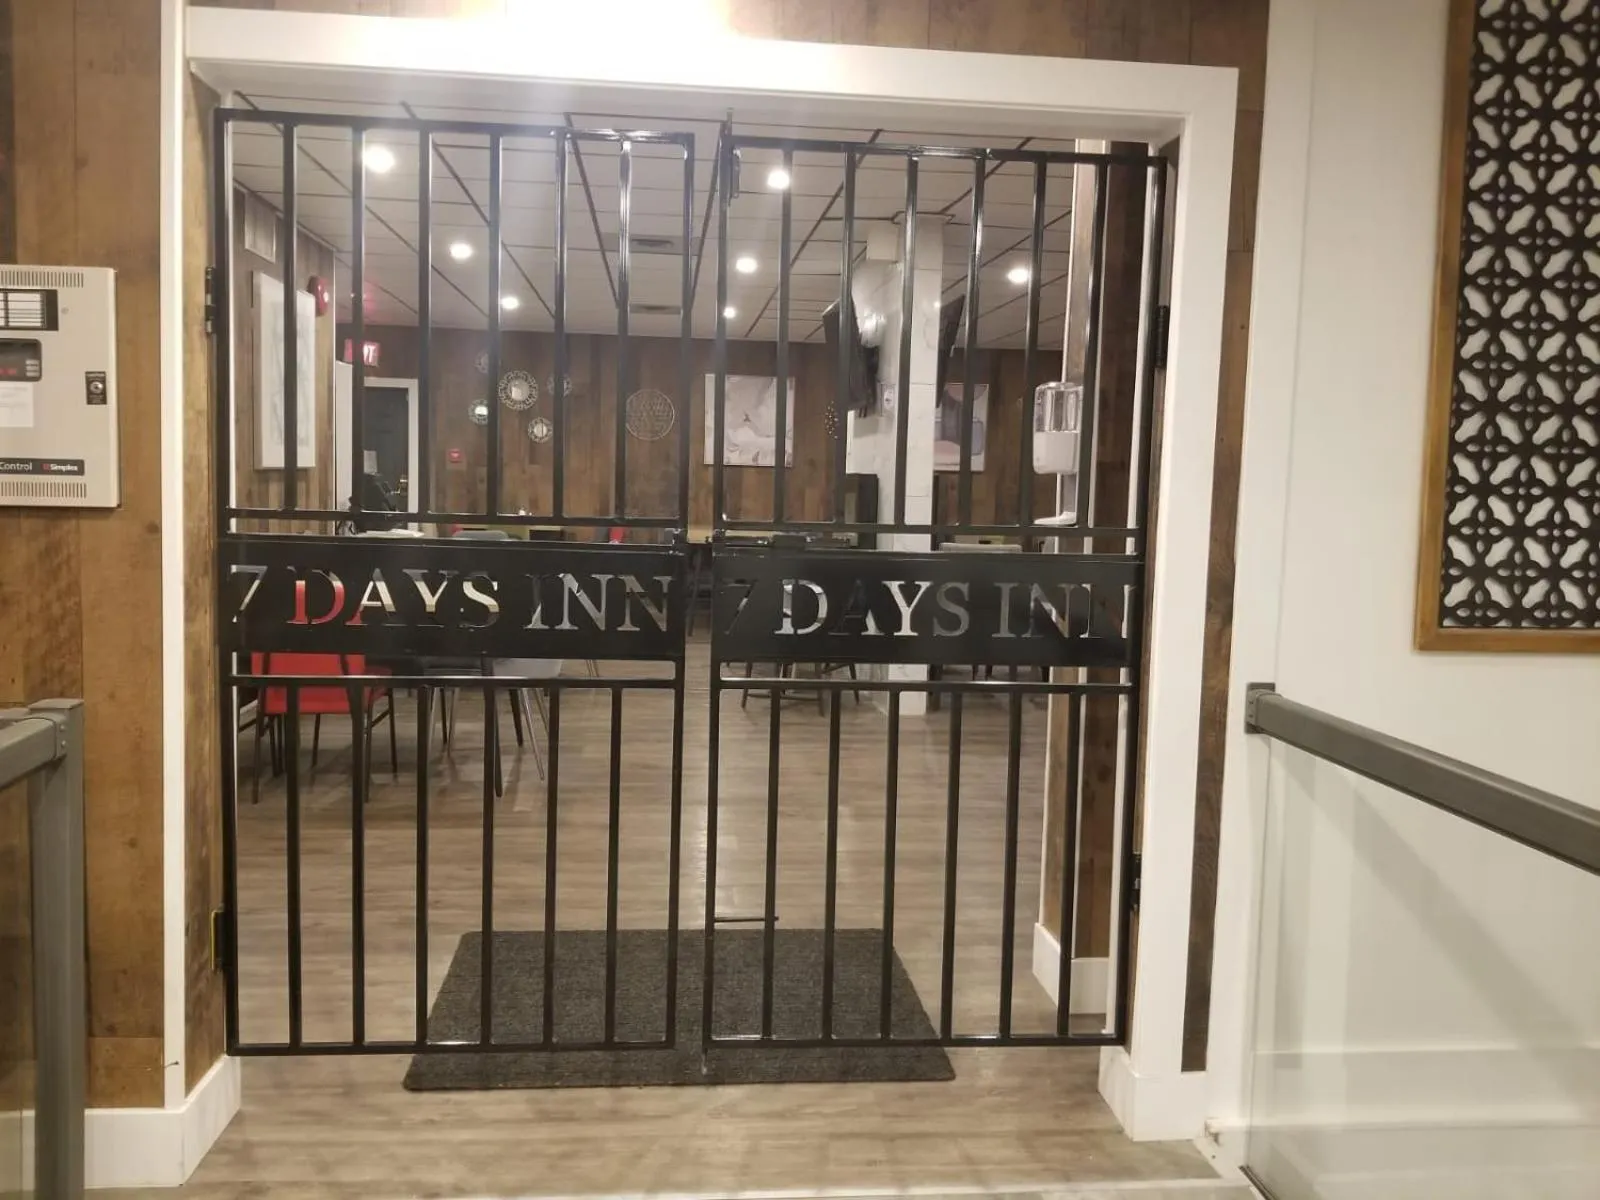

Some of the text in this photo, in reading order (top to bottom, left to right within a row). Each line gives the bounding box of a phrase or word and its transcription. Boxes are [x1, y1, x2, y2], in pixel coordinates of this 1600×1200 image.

[230, 564, 673, 632] 7 DAYS INN
[773, 578, 970, 637] DAYS
